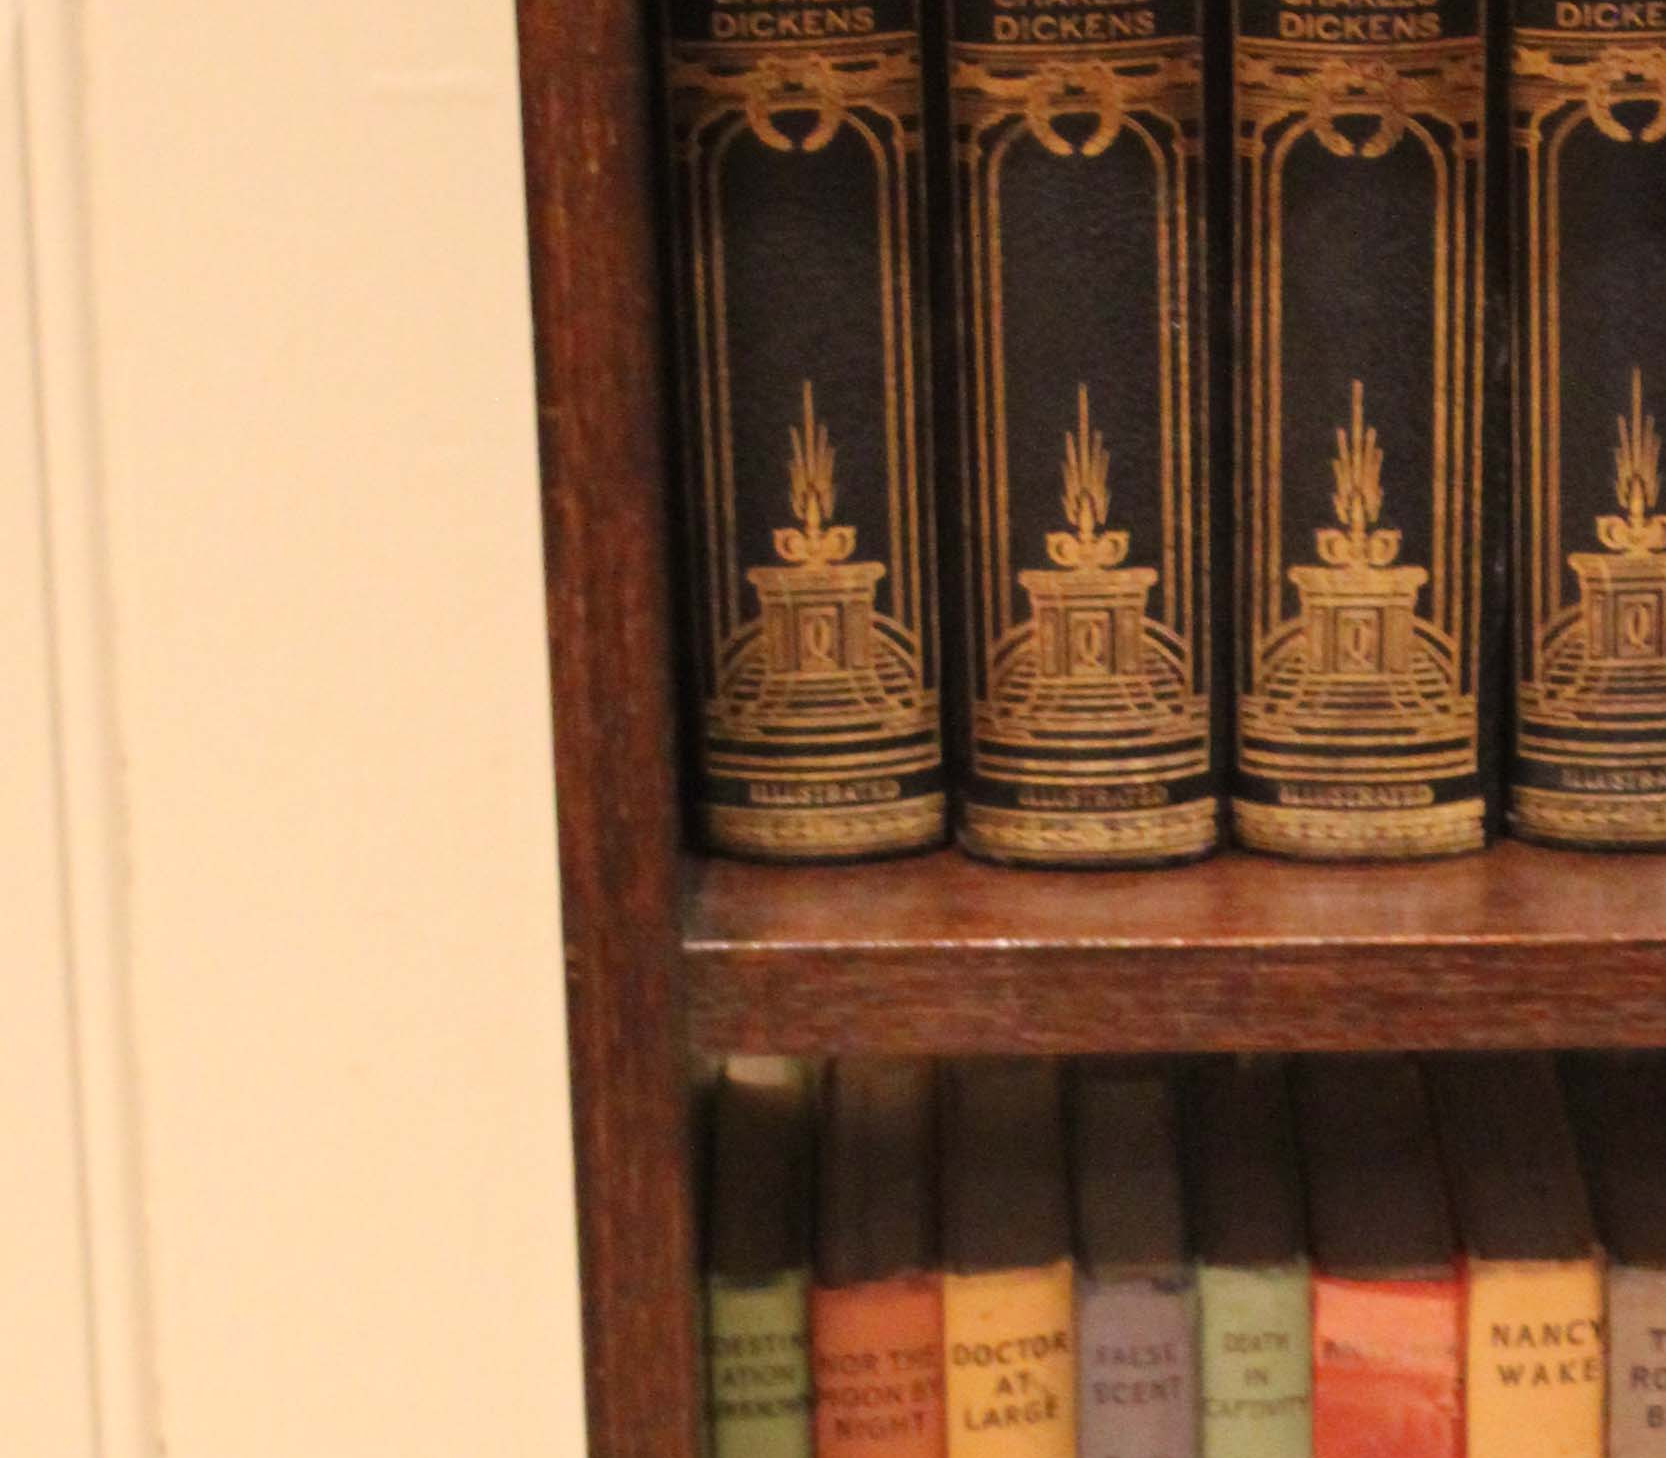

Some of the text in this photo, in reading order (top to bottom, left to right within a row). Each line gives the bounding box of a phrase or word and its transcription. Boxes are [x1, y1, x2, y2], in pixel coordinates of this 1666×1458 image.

[712, 7, 875, 39] DICKENS
[993, 11, 1154, 40] DICKENS
[1279, 11, 1441, 40] DICKENS
[1490, 1319, 1604, 1348] NANCY
[953, 1331, 1068, 1367] DOCTOR
[997, 1371, 1029, 1395] AT
[1245, 1368, 1268, 1386] IN
[1498, 1360, 1600, 1387] WAKE
[834, 1413, 925, 1440] NIGHT
[964, 1395, 1060, 1431] LARGE
